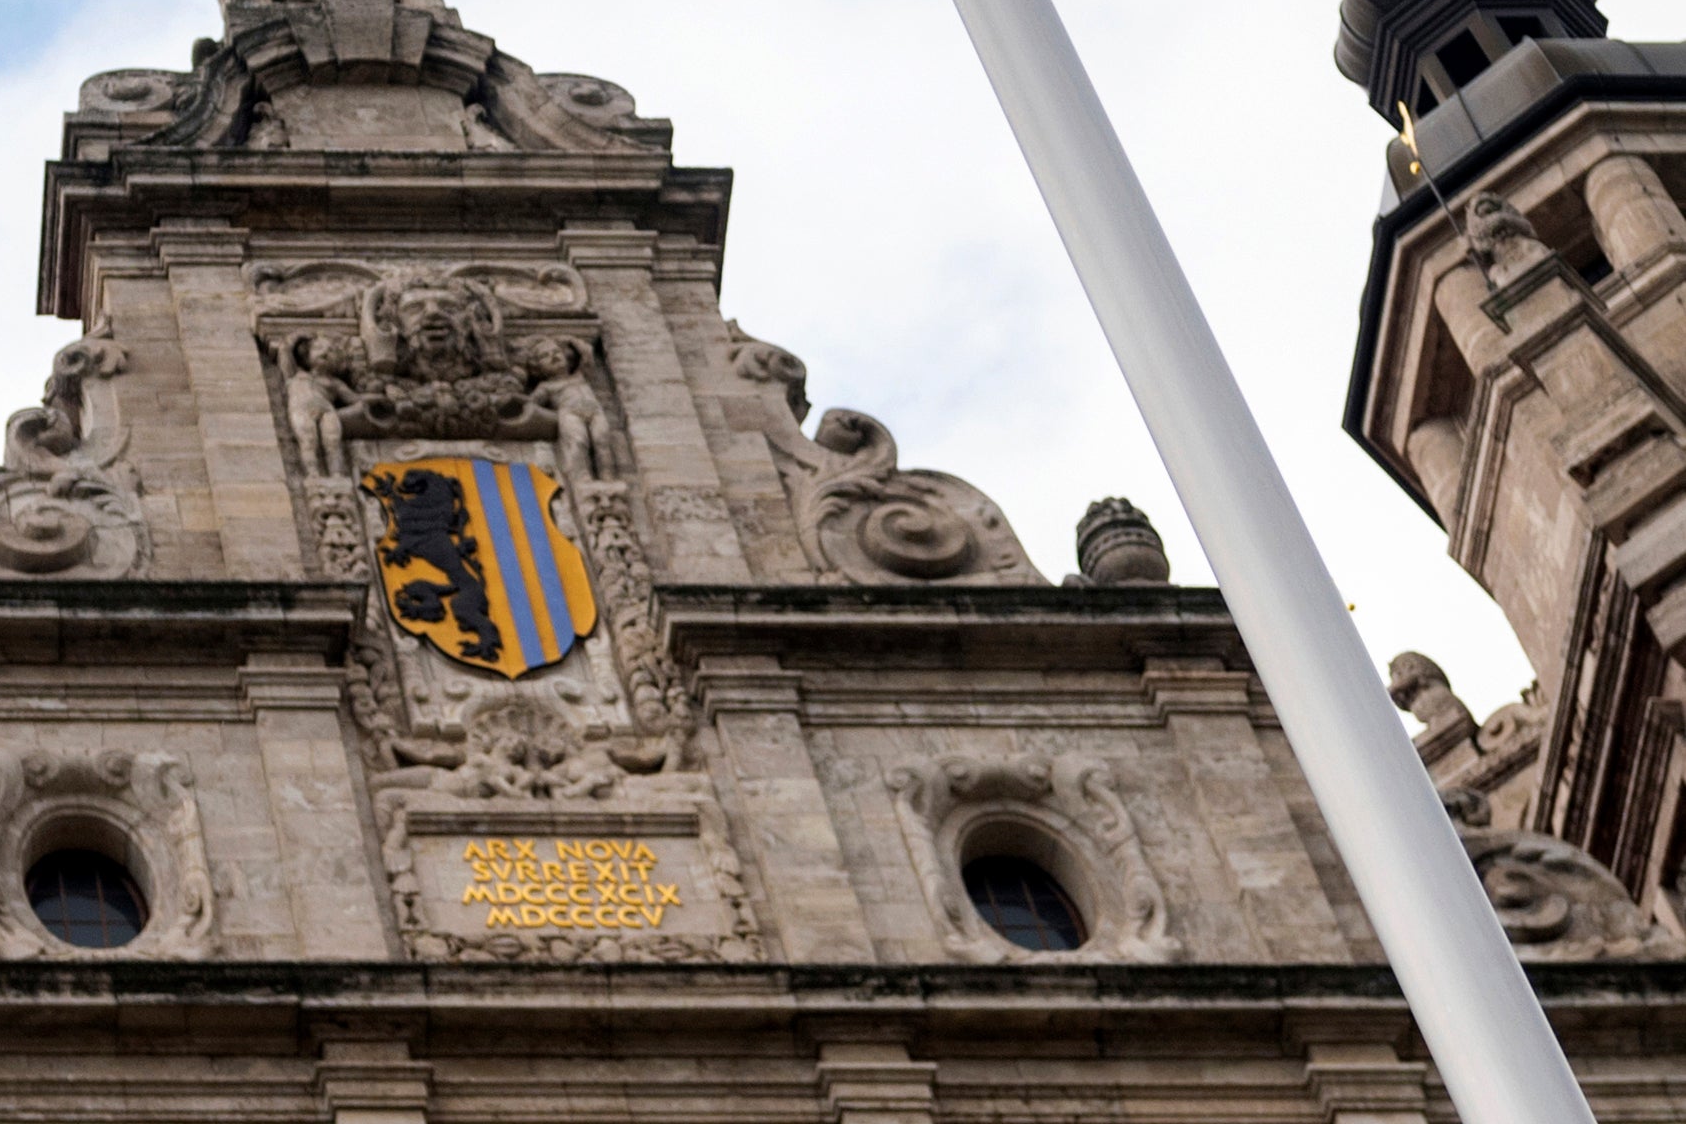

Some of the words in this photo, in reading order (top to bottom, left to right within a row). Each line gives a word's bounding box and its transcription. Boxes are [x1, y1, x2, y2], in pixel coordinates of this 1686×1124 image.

[463, 839, 538, 861] ARX
[554, 839, 657, 862] NOVA
[471, 861, 655, 883] SVRREXIT
[462, 882, 681, 905] MDCCCXCIX
[485, 905, 664, 928] MDCCCCV
